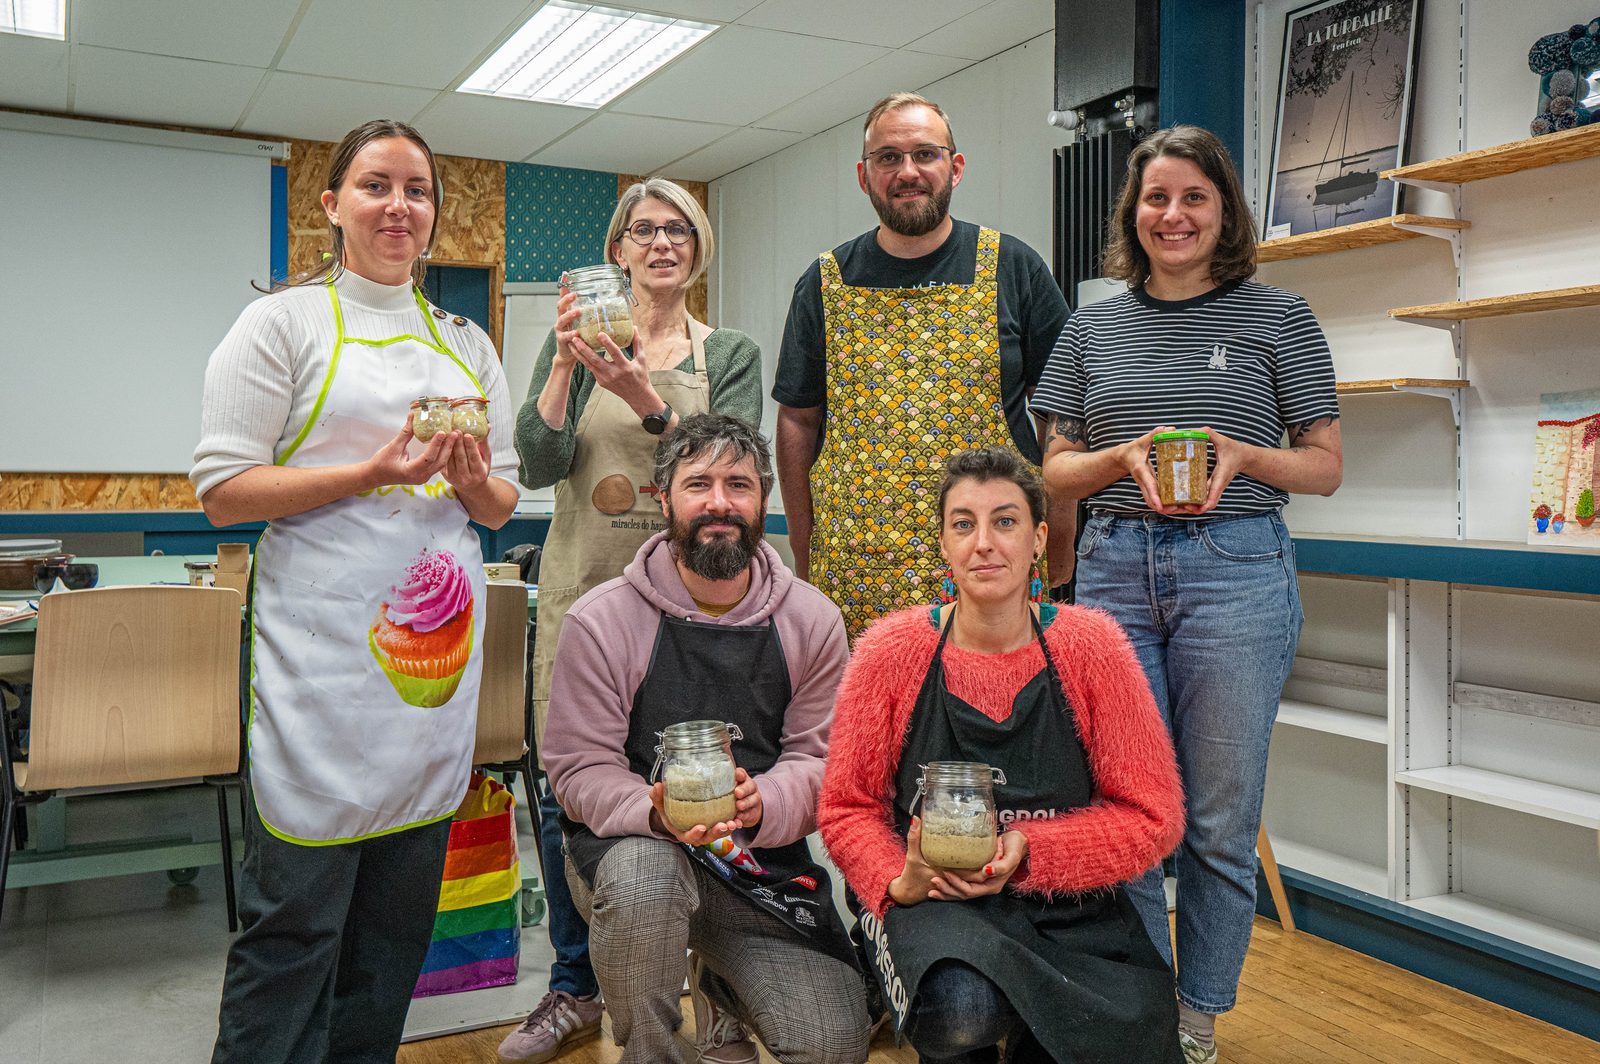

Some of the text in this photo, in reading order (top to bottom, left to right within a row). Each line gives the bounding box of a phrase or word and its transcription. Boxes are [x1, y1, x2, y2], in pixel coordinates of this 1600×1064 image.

[1307, 4, 1393, 47] LA TURBALLE
[611, 518, 641, 530] miracles
[641, 519, 650, 530] do
